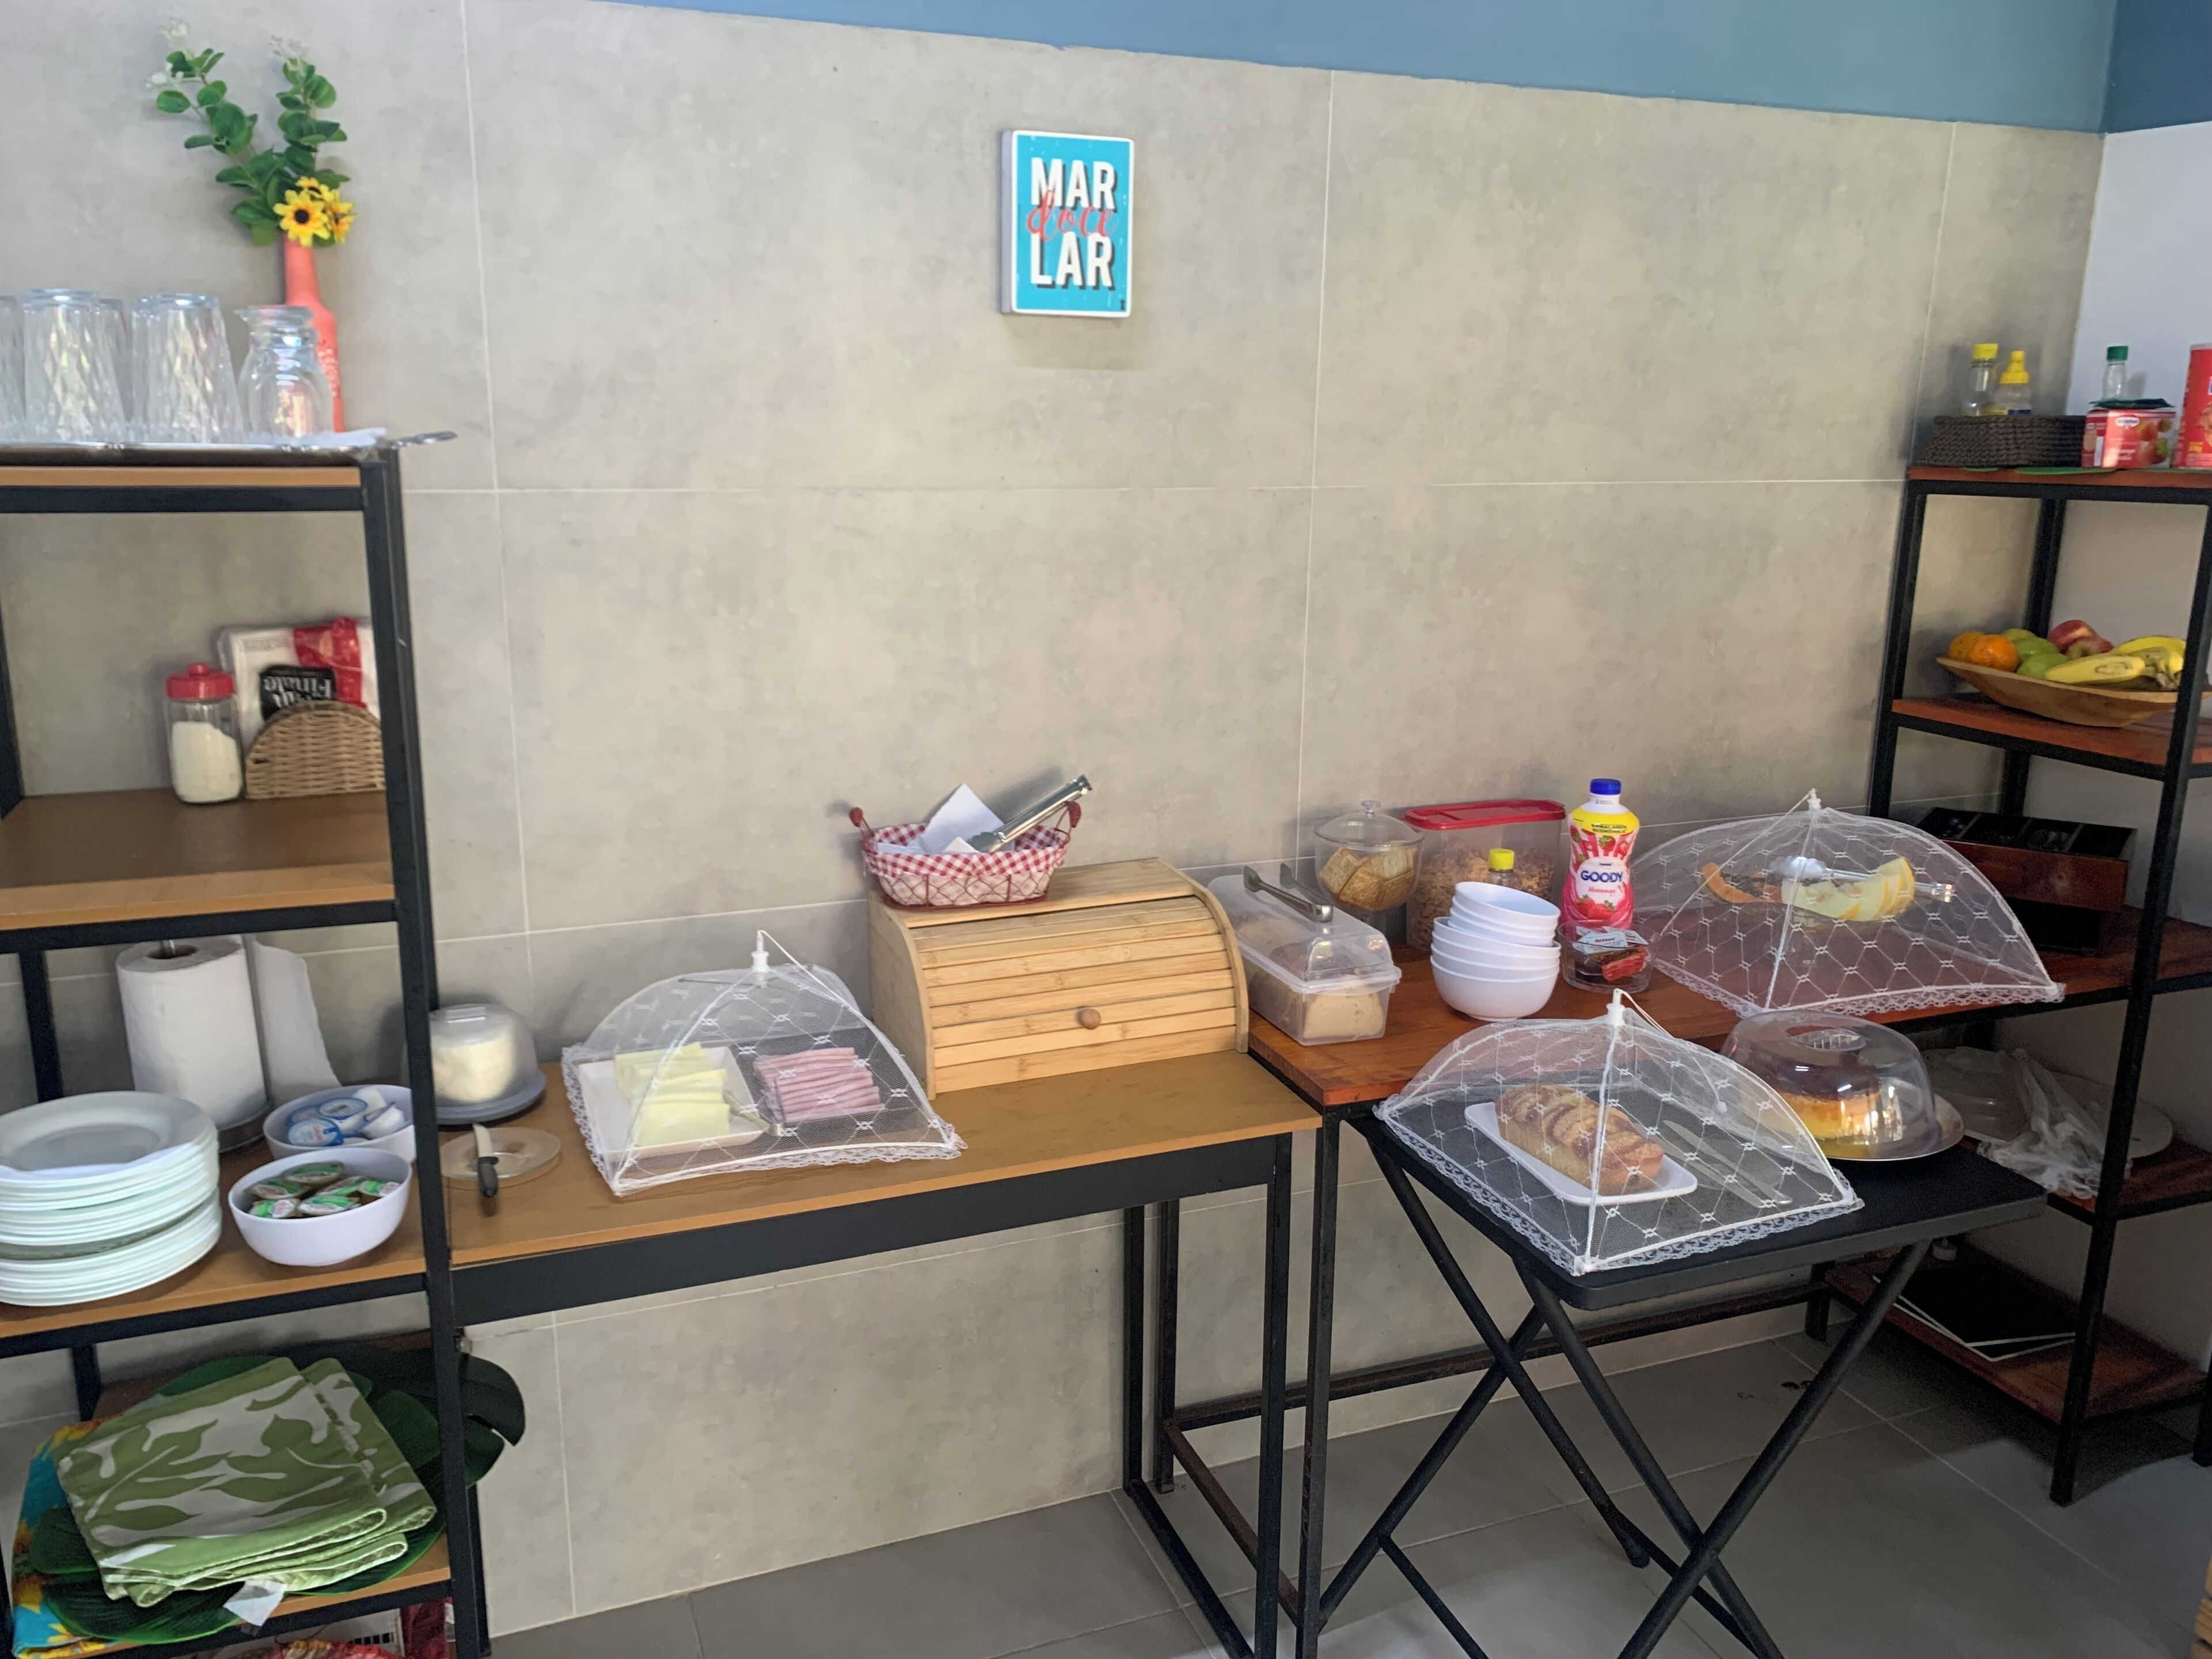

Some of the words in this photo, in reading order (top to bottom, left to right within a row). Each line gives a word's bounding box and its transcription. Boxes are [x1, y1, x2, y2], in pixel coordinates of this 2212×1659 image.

[1031, 157, 1116, 211] MAR
[1031, 232, 1115, 289] LAR
[1581, 870, 1623, 882] GOODY
[1588, 887, 1616, 896] Morango
